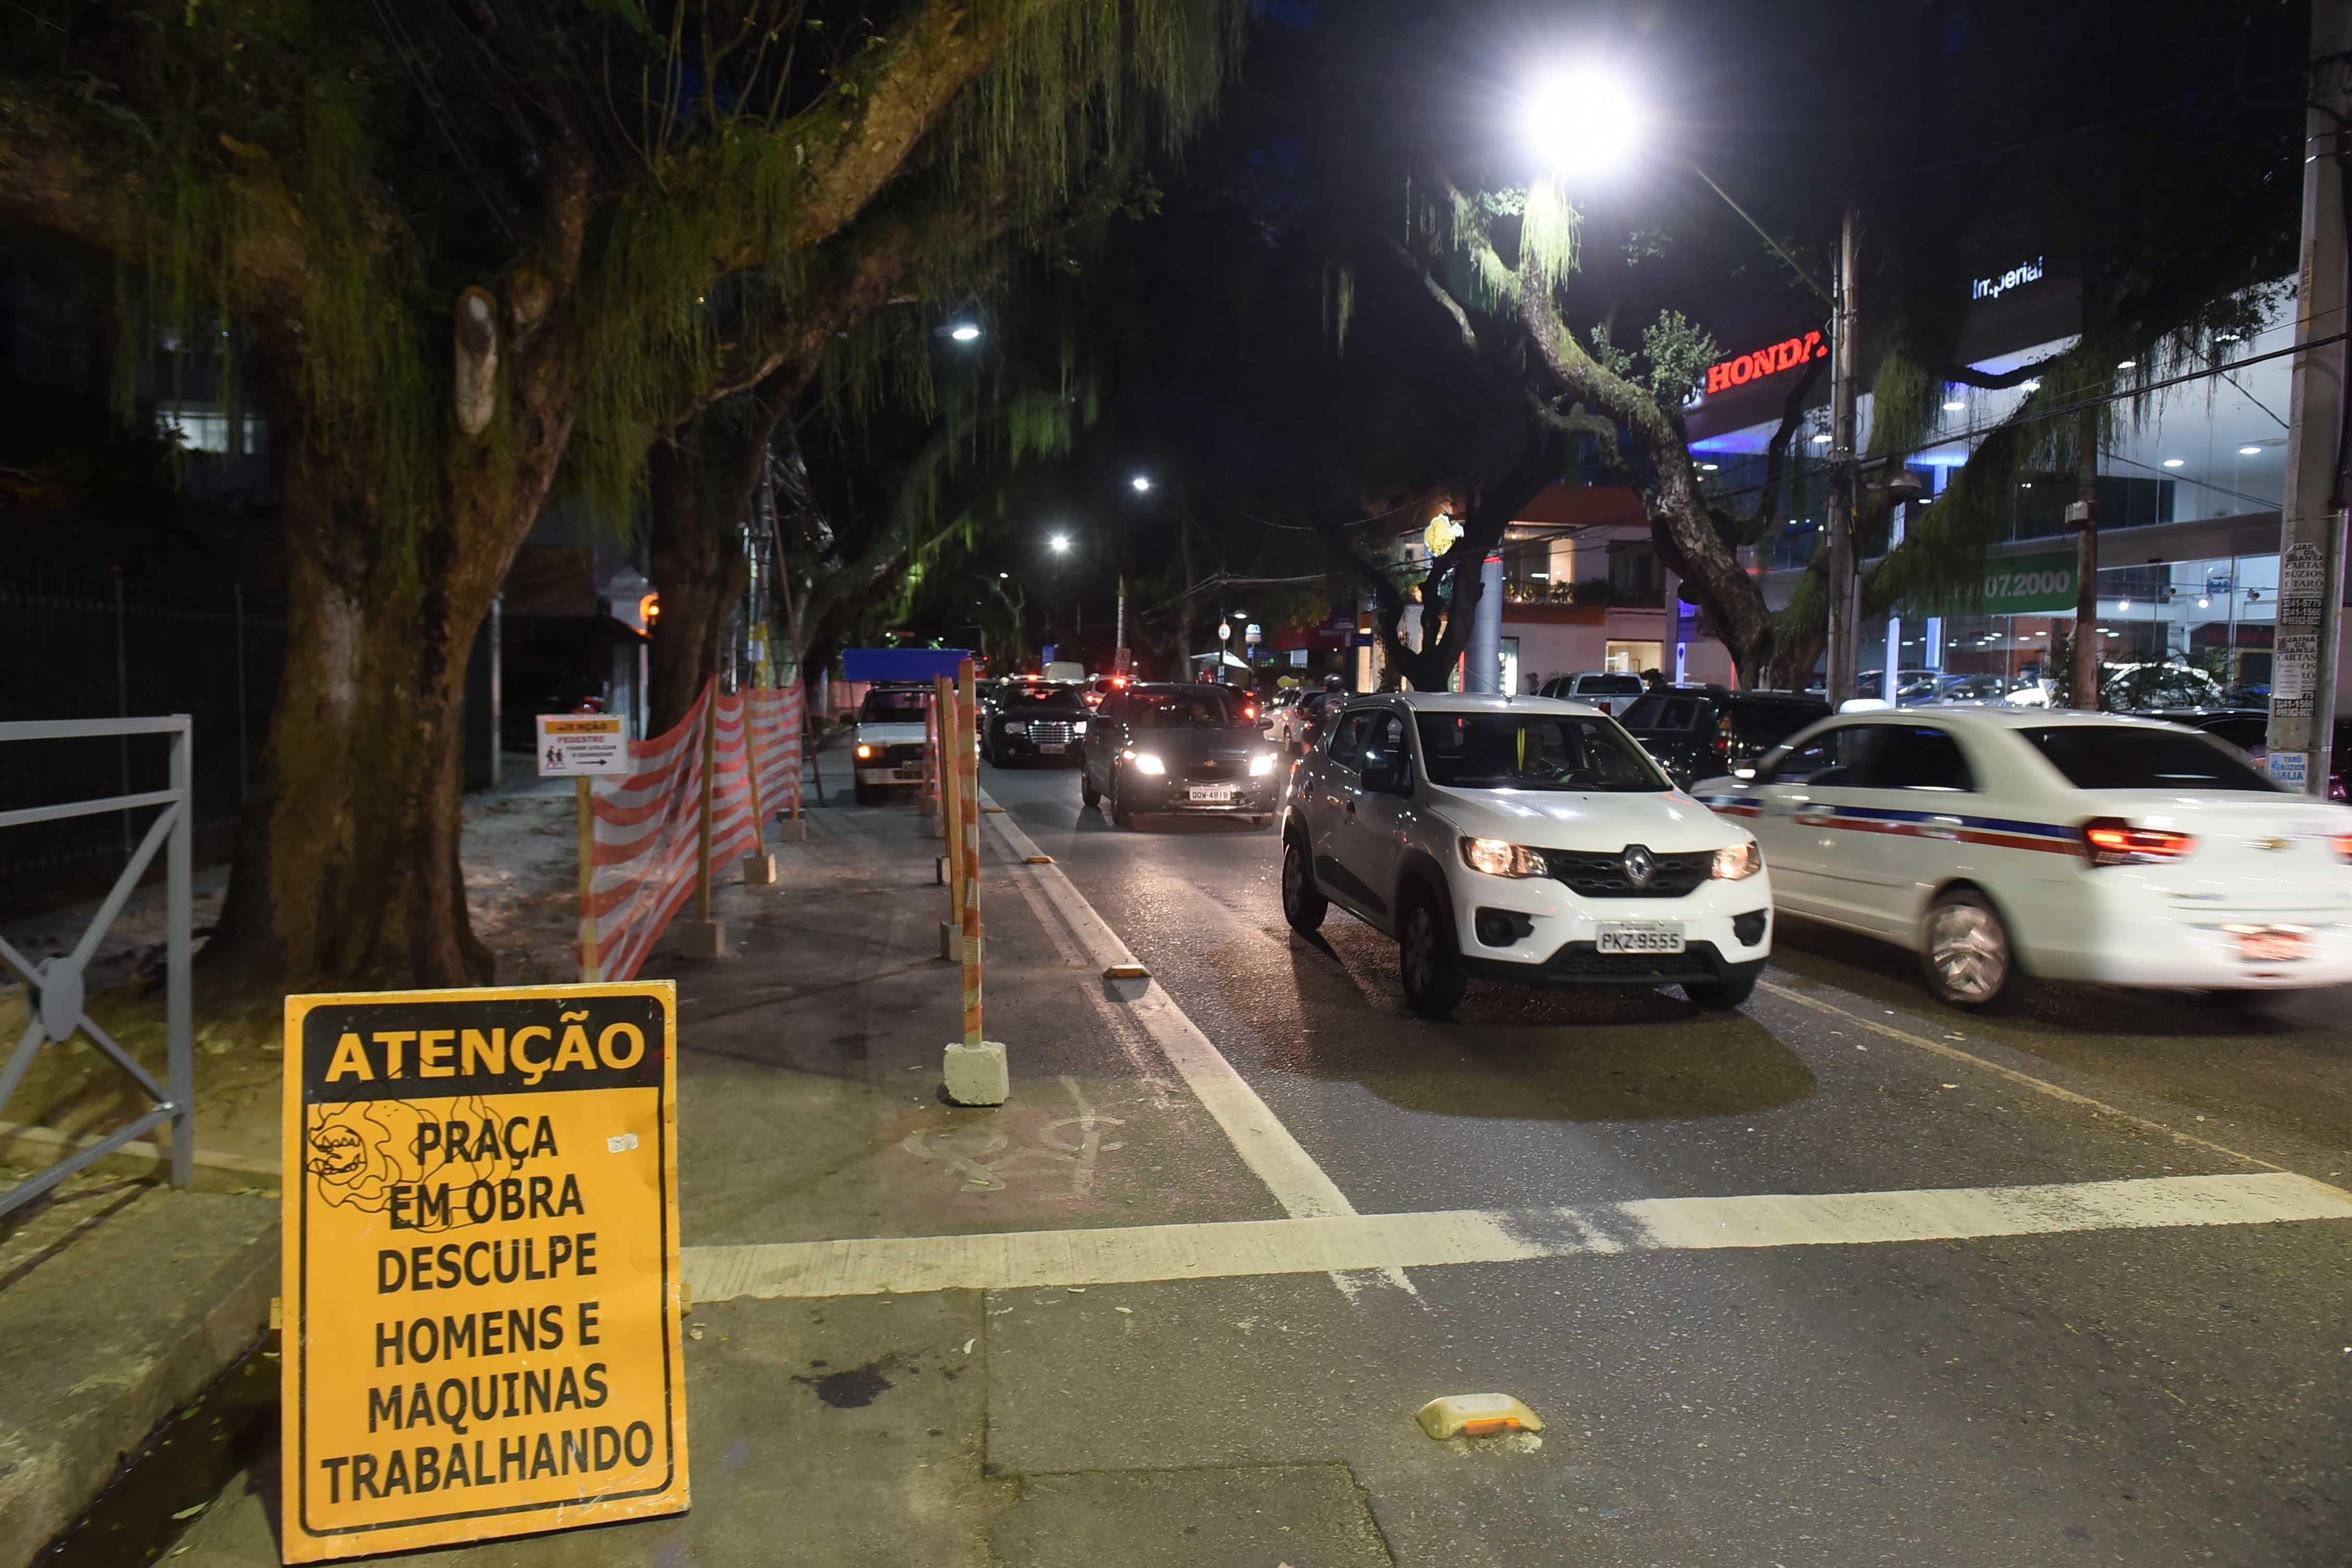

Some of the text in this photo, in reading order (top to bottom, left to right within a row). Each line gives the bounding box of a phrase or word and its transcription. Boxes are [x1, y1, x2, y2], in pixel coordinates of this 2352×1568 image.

[1973, 255, 2043, 300] Imperial
[2285, 561, 2323, 570] CARTAS
[2277, 653, 2316, 661] CARTAS
[324, 1010, 645, 1086] ATENÇÃO
[418, 1115, 558, 1171] PRAÇA
[390, 1174, 584, 1230] EM OBRA
[377, 1233, 597, 1294] DESCULPE
[375, 1302, 600, 1368] HOMENS E
[368, 1363, 609, 1435] MAQUINAS
[322, 1420, 653, 1504] TRABALHANDO
